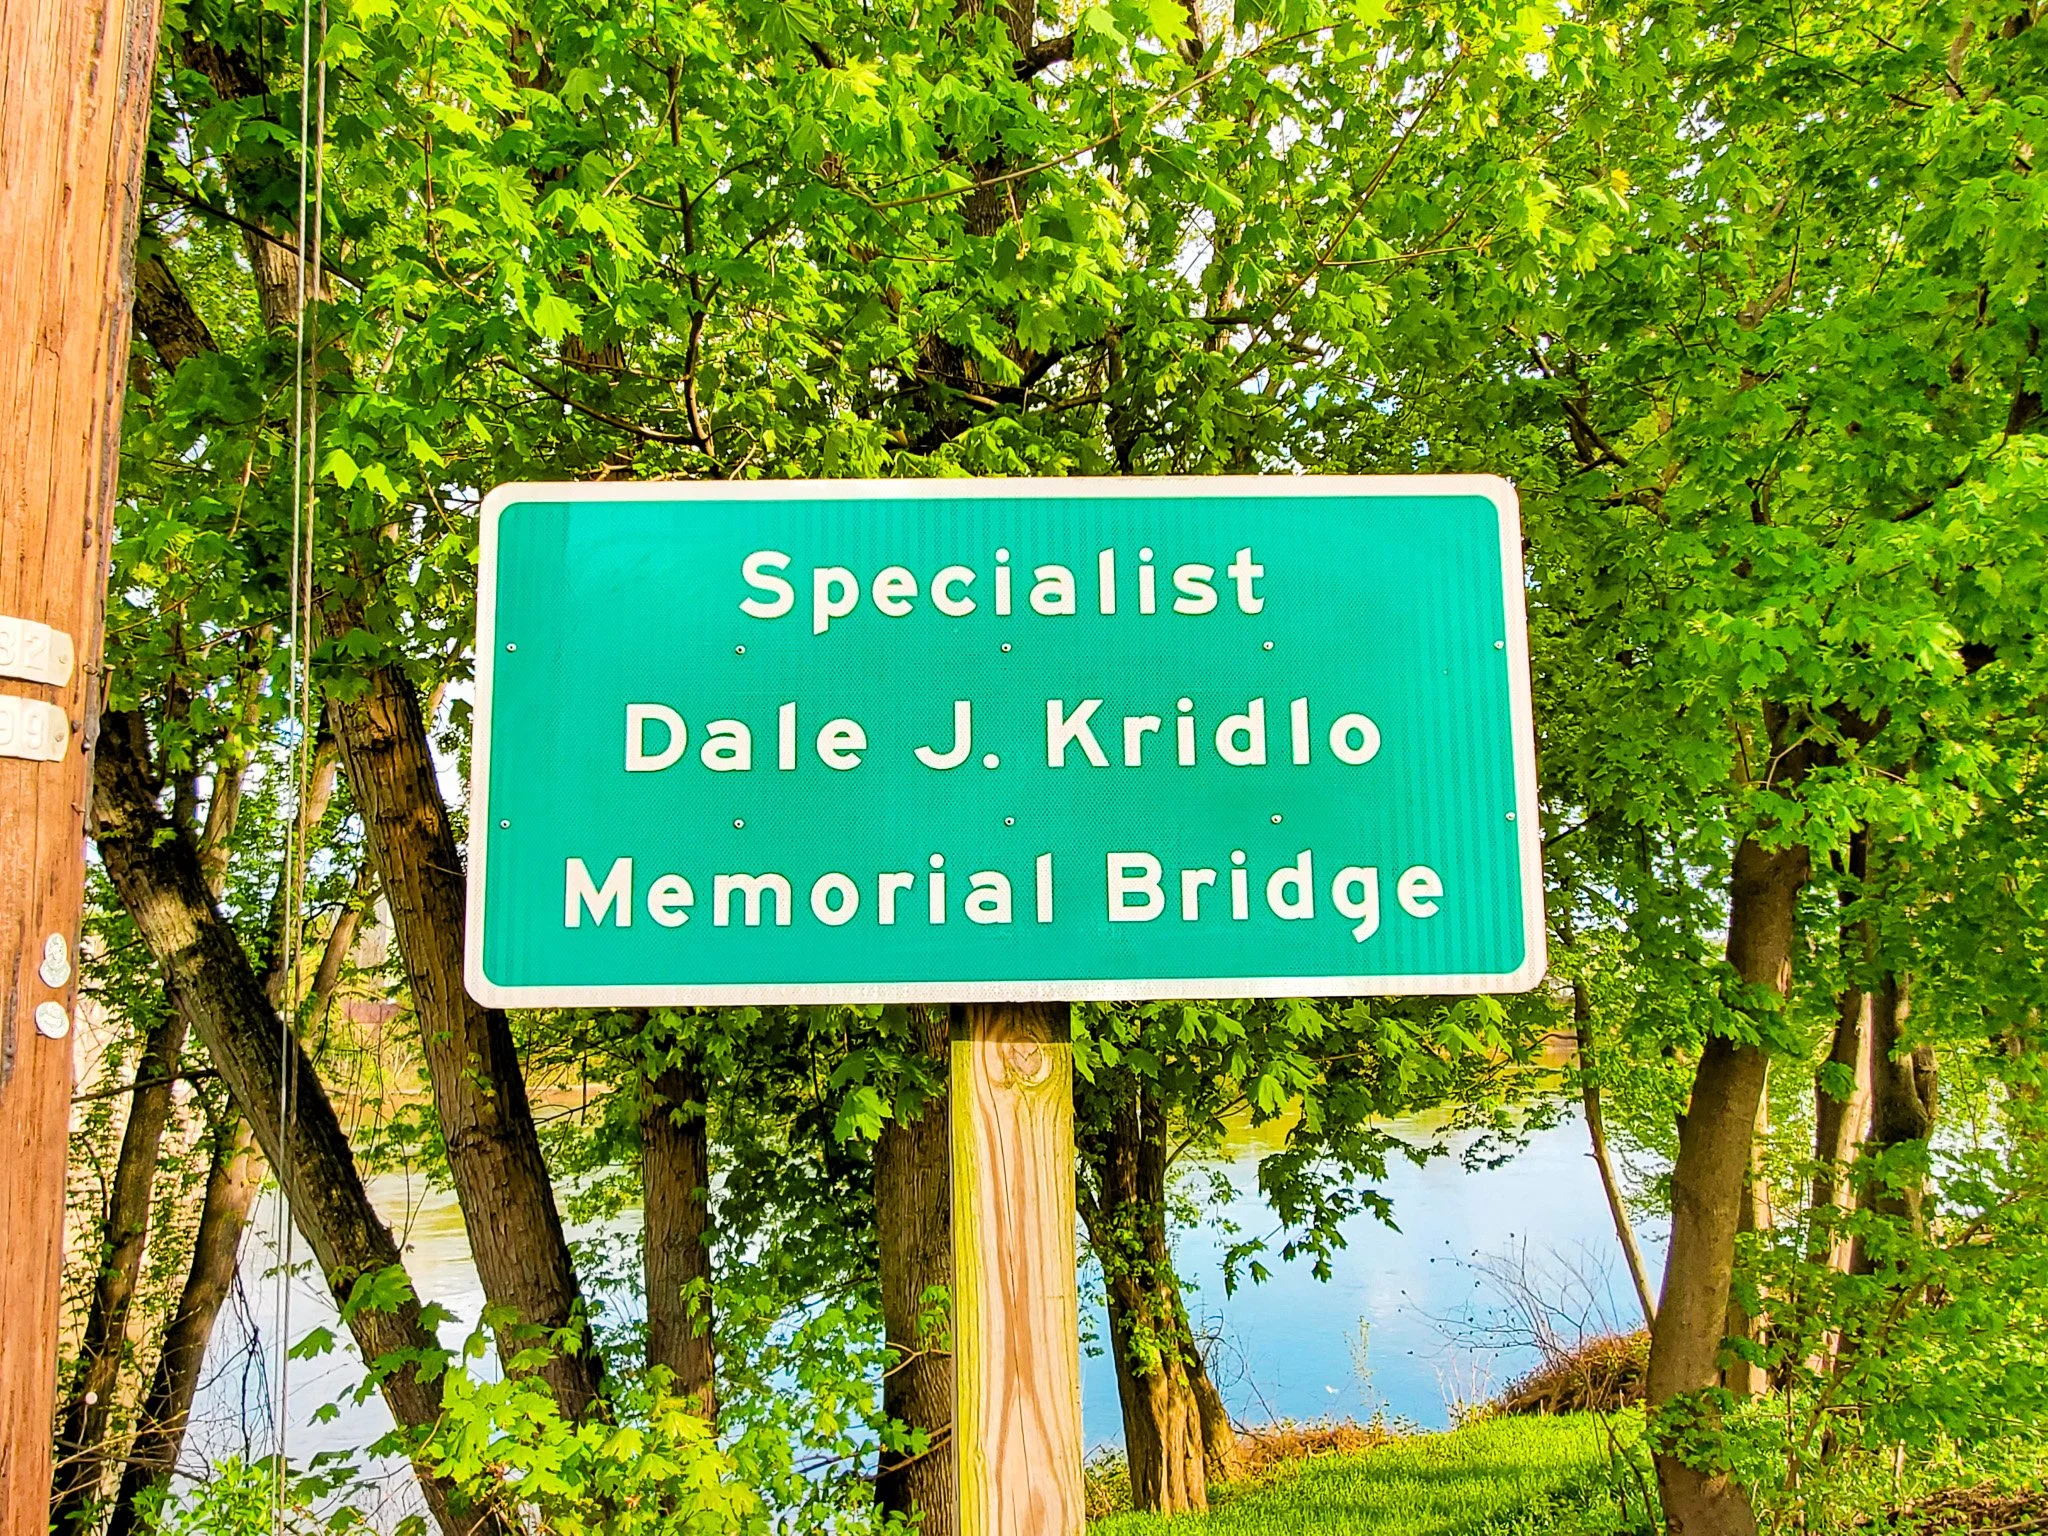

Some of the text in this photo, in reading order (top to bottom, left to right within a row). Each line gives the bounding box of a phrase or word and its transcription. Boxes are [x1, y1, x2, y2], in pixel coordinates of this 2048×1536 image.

[739, 547, 1266, 635] Specialist
[625, 697, 1382, 772] Dale J. Kridlo
[563, 849, 1445, 943] Memorial Bridge
